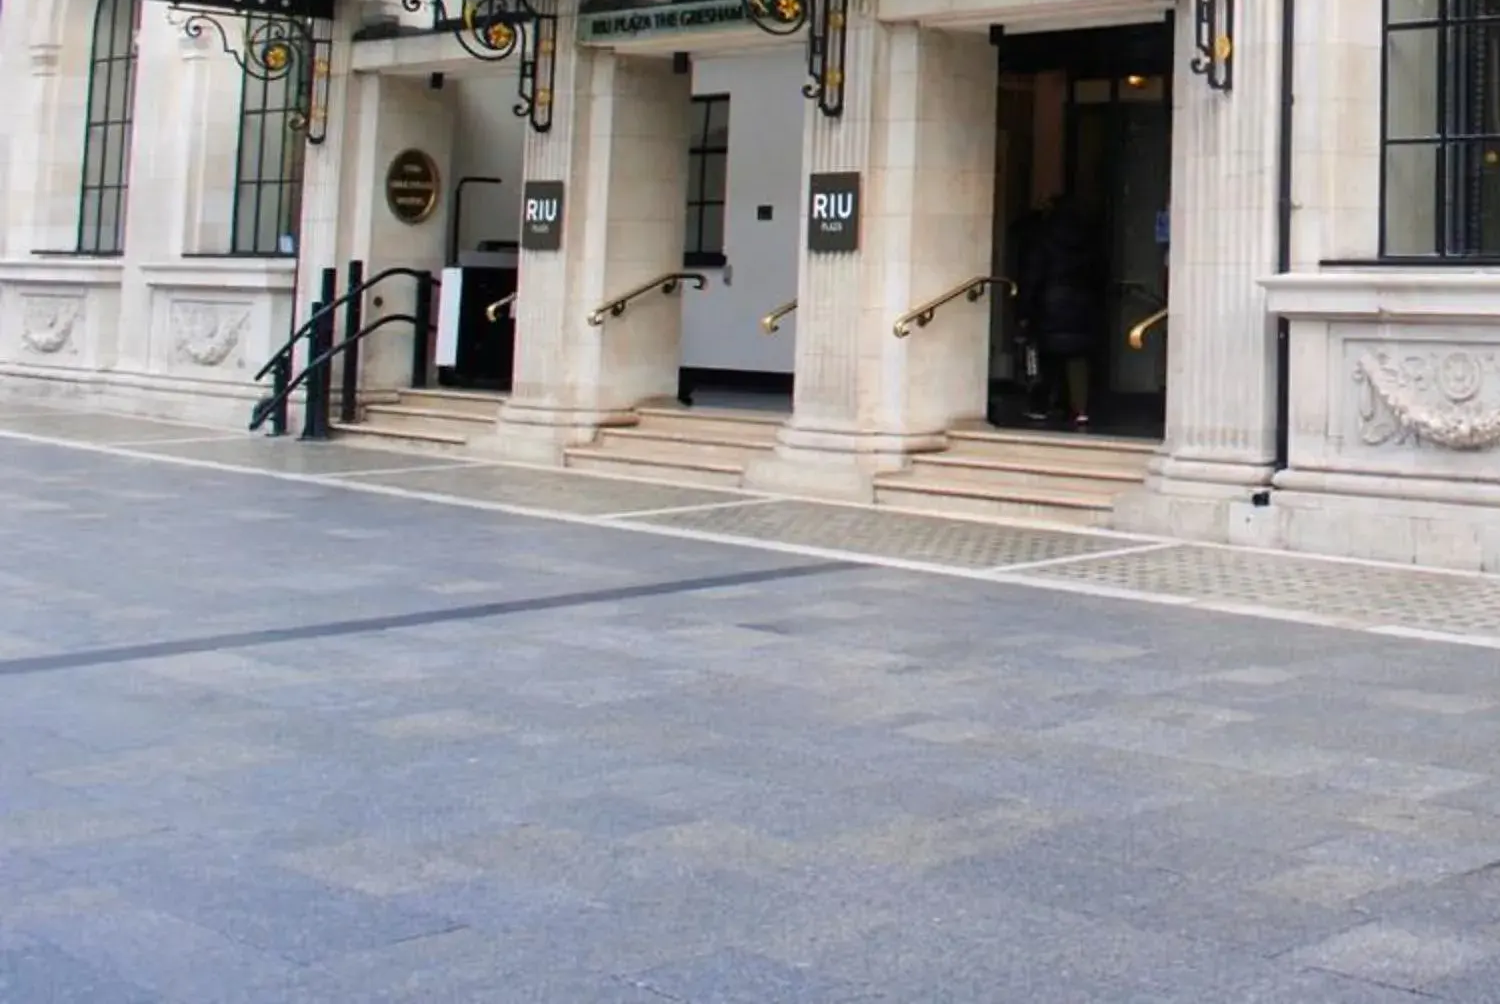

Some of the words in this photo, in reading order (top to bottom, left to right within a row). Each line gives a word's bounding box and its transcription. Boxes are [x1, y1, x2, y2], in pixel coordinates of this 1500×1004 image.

[613, 14, 652, 33] PLAZA
[526, 198, 557, 222] RIU
[813, 192, 853, 219] RIU
